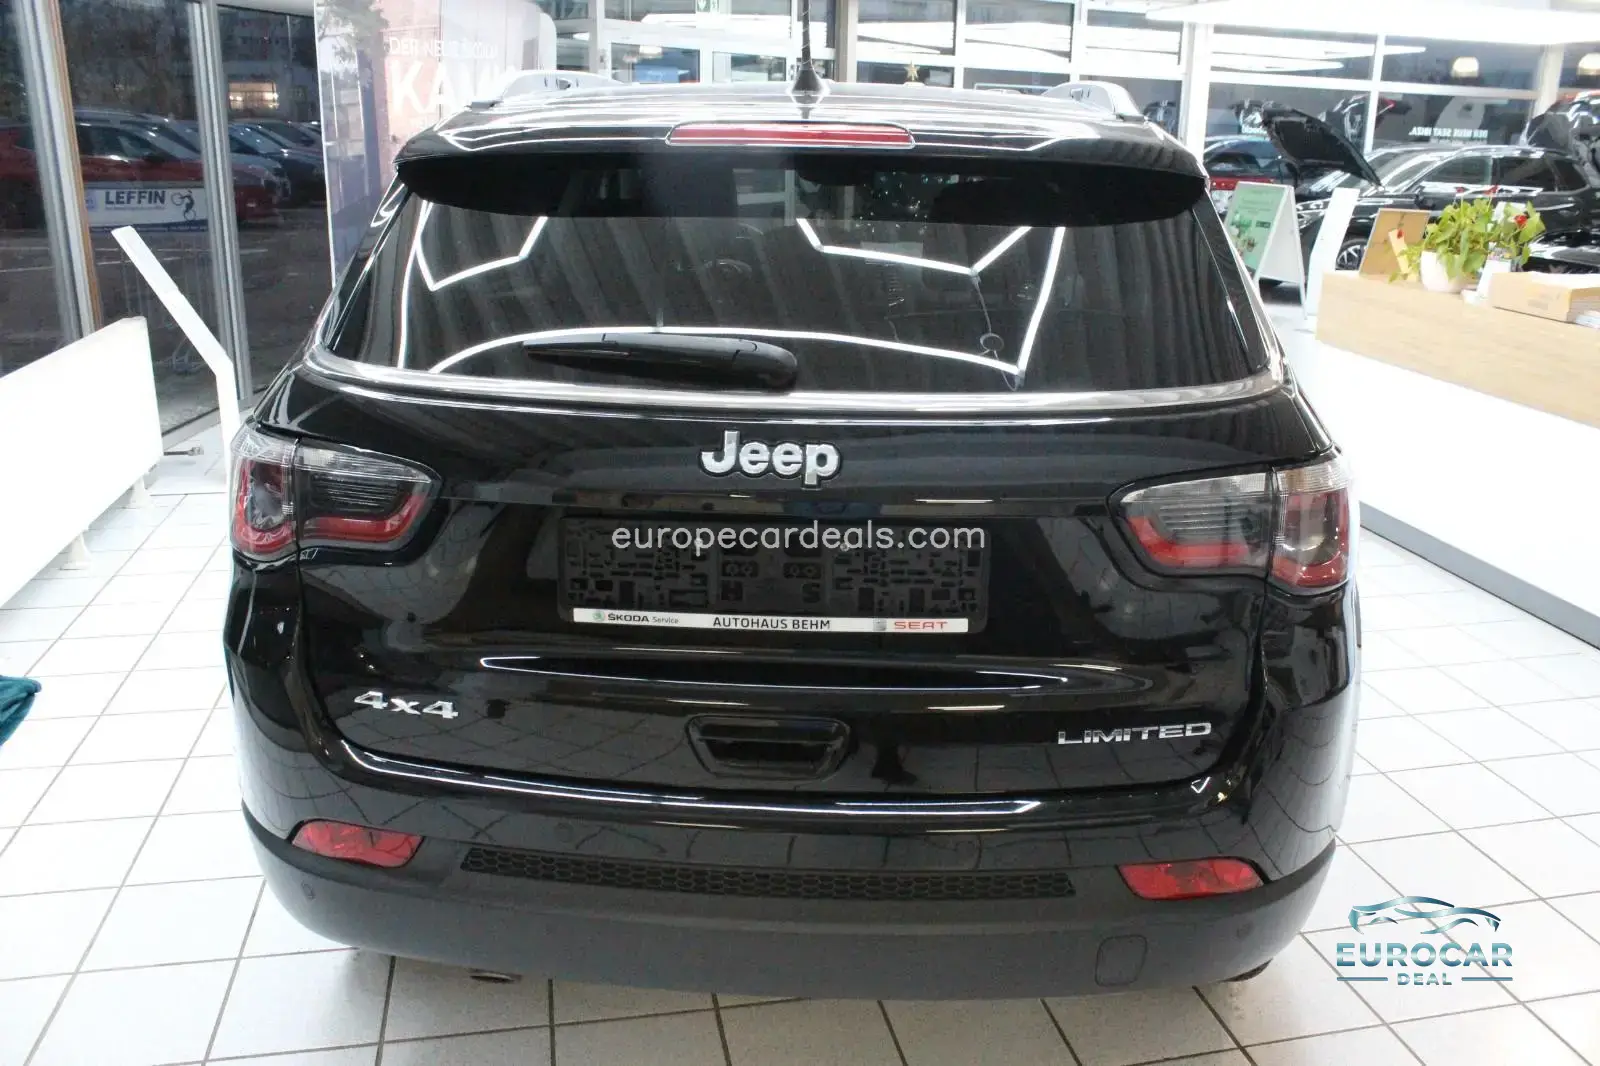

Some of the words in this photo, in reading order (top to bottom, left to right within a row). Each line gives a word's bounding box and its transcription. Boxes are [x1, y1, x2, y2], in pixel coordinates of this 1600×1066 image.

[104, 189, 166, 205] LEFFIN
[700, 428, 841, 487] Jeep
[607, 612, 650, 622] ŠKODA
[652, 615, 680, 625] Service
[712, 616, 788, 629] AUTOHAUS
[792, 618, 831, 630] BEHM
[893, 621, 949, 630] SEAT
[353, 690, 459, 719] 4x4
[1057, 721, 1212, 745] LIMITED
